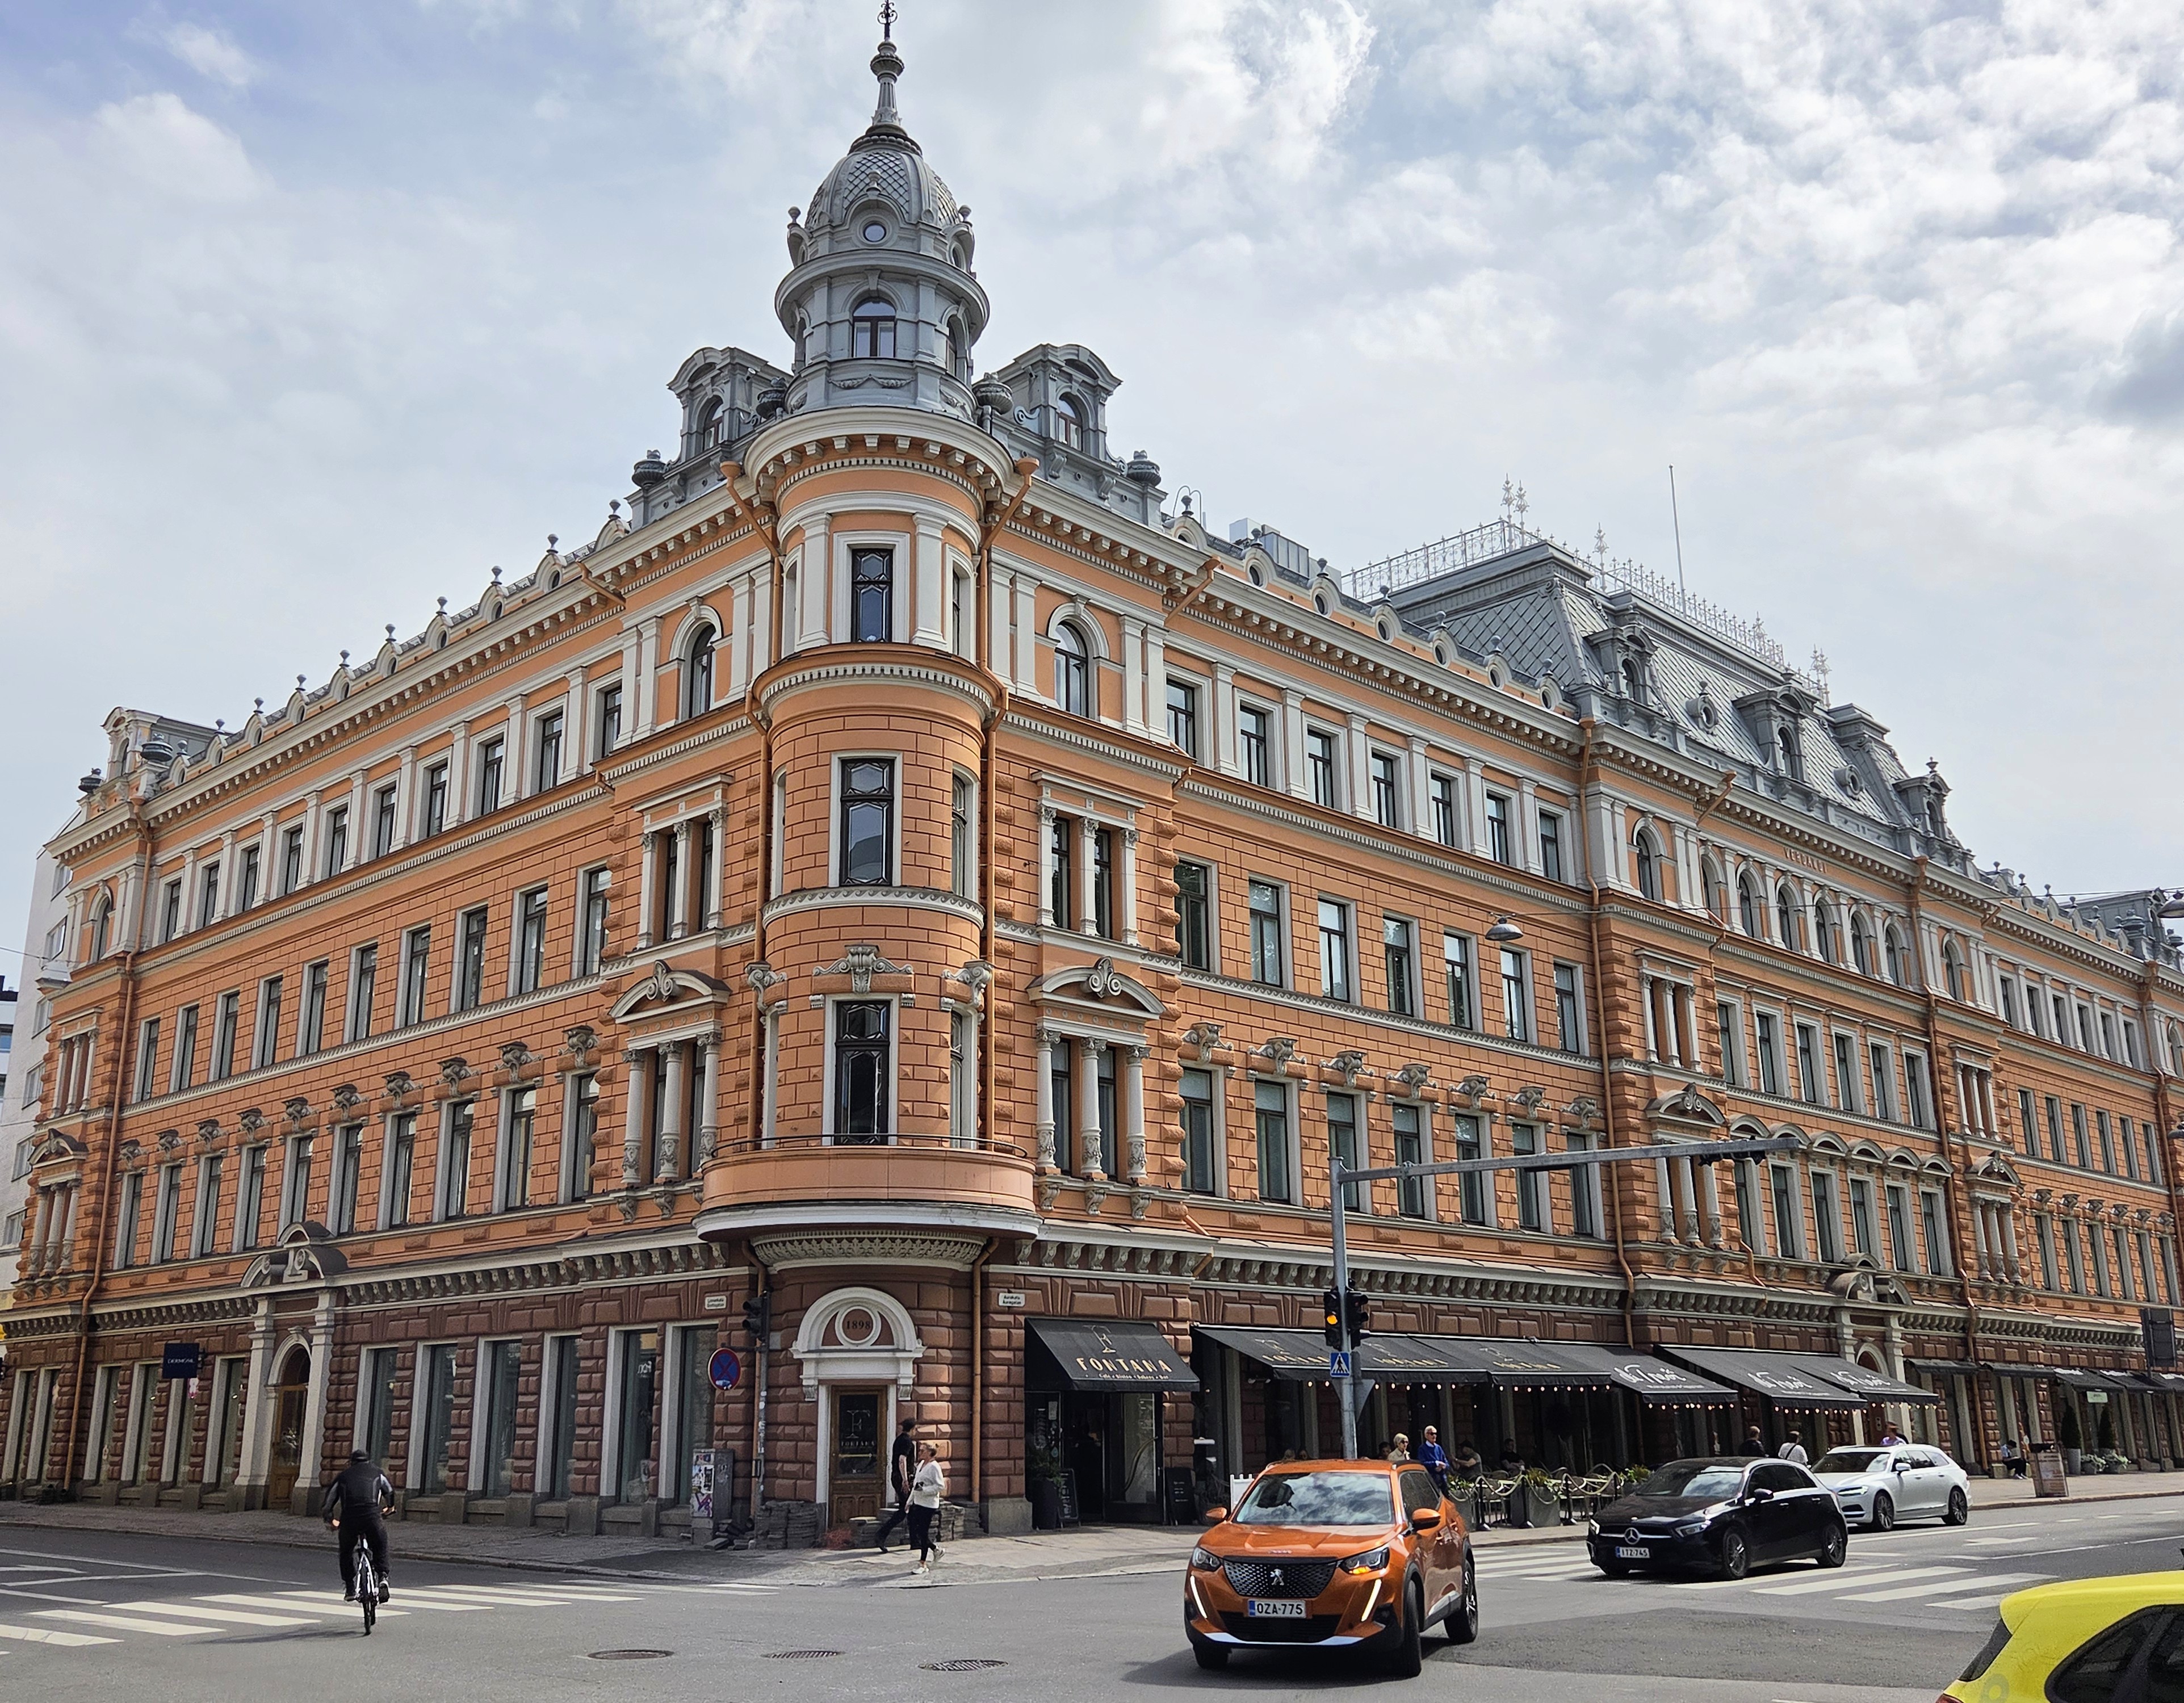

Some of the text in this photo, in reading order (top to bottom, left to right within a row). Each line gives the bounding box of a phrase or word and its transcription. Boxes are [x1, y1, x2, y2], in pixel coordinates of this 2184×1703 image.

[846, 1320, 870, 1329] 1898
[1076, 1357, 1172, 1373] FONTANA
[1256, 1603, 1303, 1615] OZA-775
